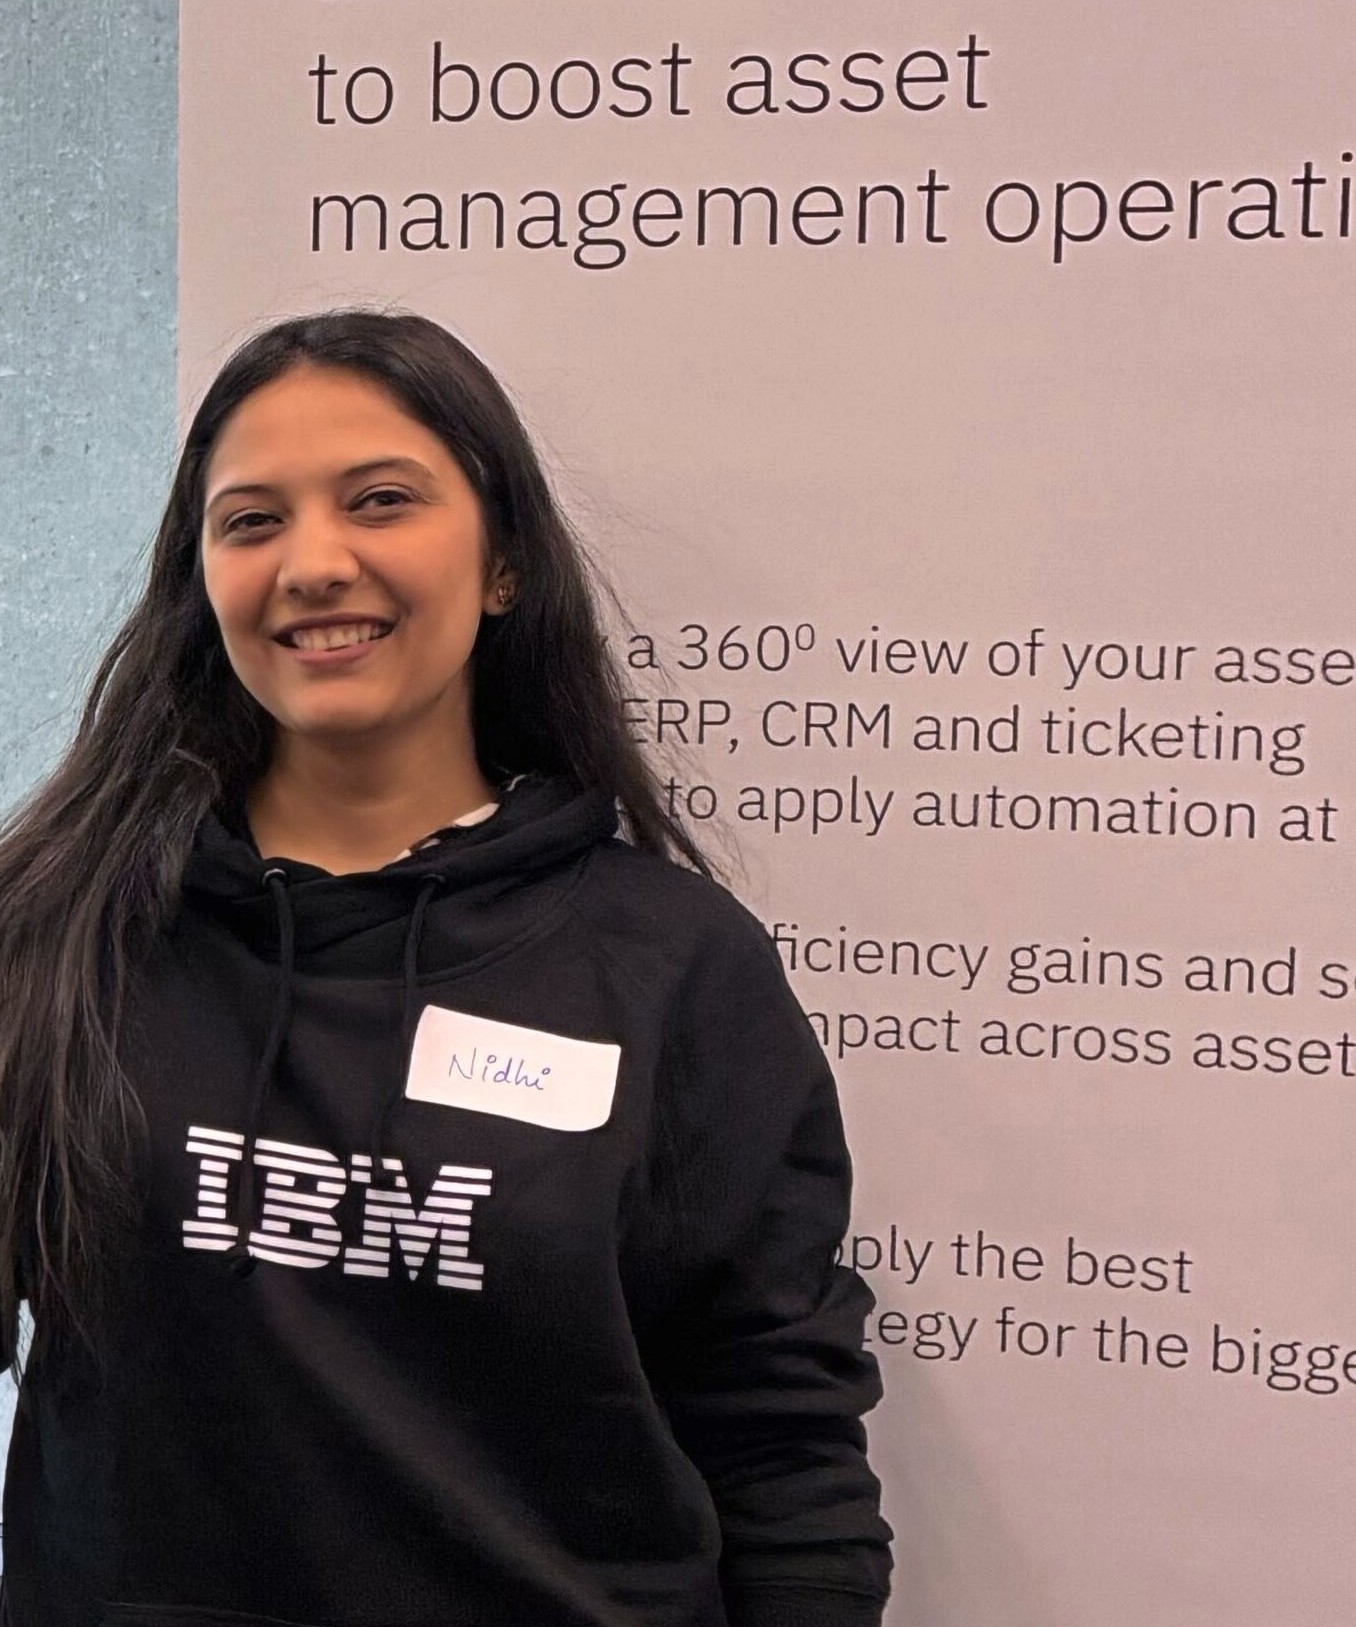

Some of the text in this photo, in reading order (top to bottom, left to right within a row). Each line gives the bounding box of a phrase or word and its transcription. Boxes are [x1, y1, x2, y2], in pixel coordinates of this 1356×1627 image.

[308, 34, 990, 125] to boost asset
[312, 152, 1354, 270] management operati
[627, 634, 660, 670] a
[836, 625, 969, 675] view
[988, 628, 1045, 677] of
[1062, 643, 1197, 691] your
[1214, 646, 1356, 686] asse
[621, 697, 1306, 776] ERP, CRM and ticketing
[664, 775, 1338, 843] to apply automation at
[1007, 936, 1163, 995] gains
[1184, 946, 1296, 996] and
[448, 1046, 552, 1092] Nidhi
[979, 1020, 1171, 1065] across
[1193, 1032, 1356, 1077] asset
[182, 1126, 493, 1291] IBM
[834, 1224, 1193, 1294] ply the best
[862, 1311, 978, 1362] egy
[995, 1306, 1077, 1358] for
[1093, 1316, 1189, 1369] the
